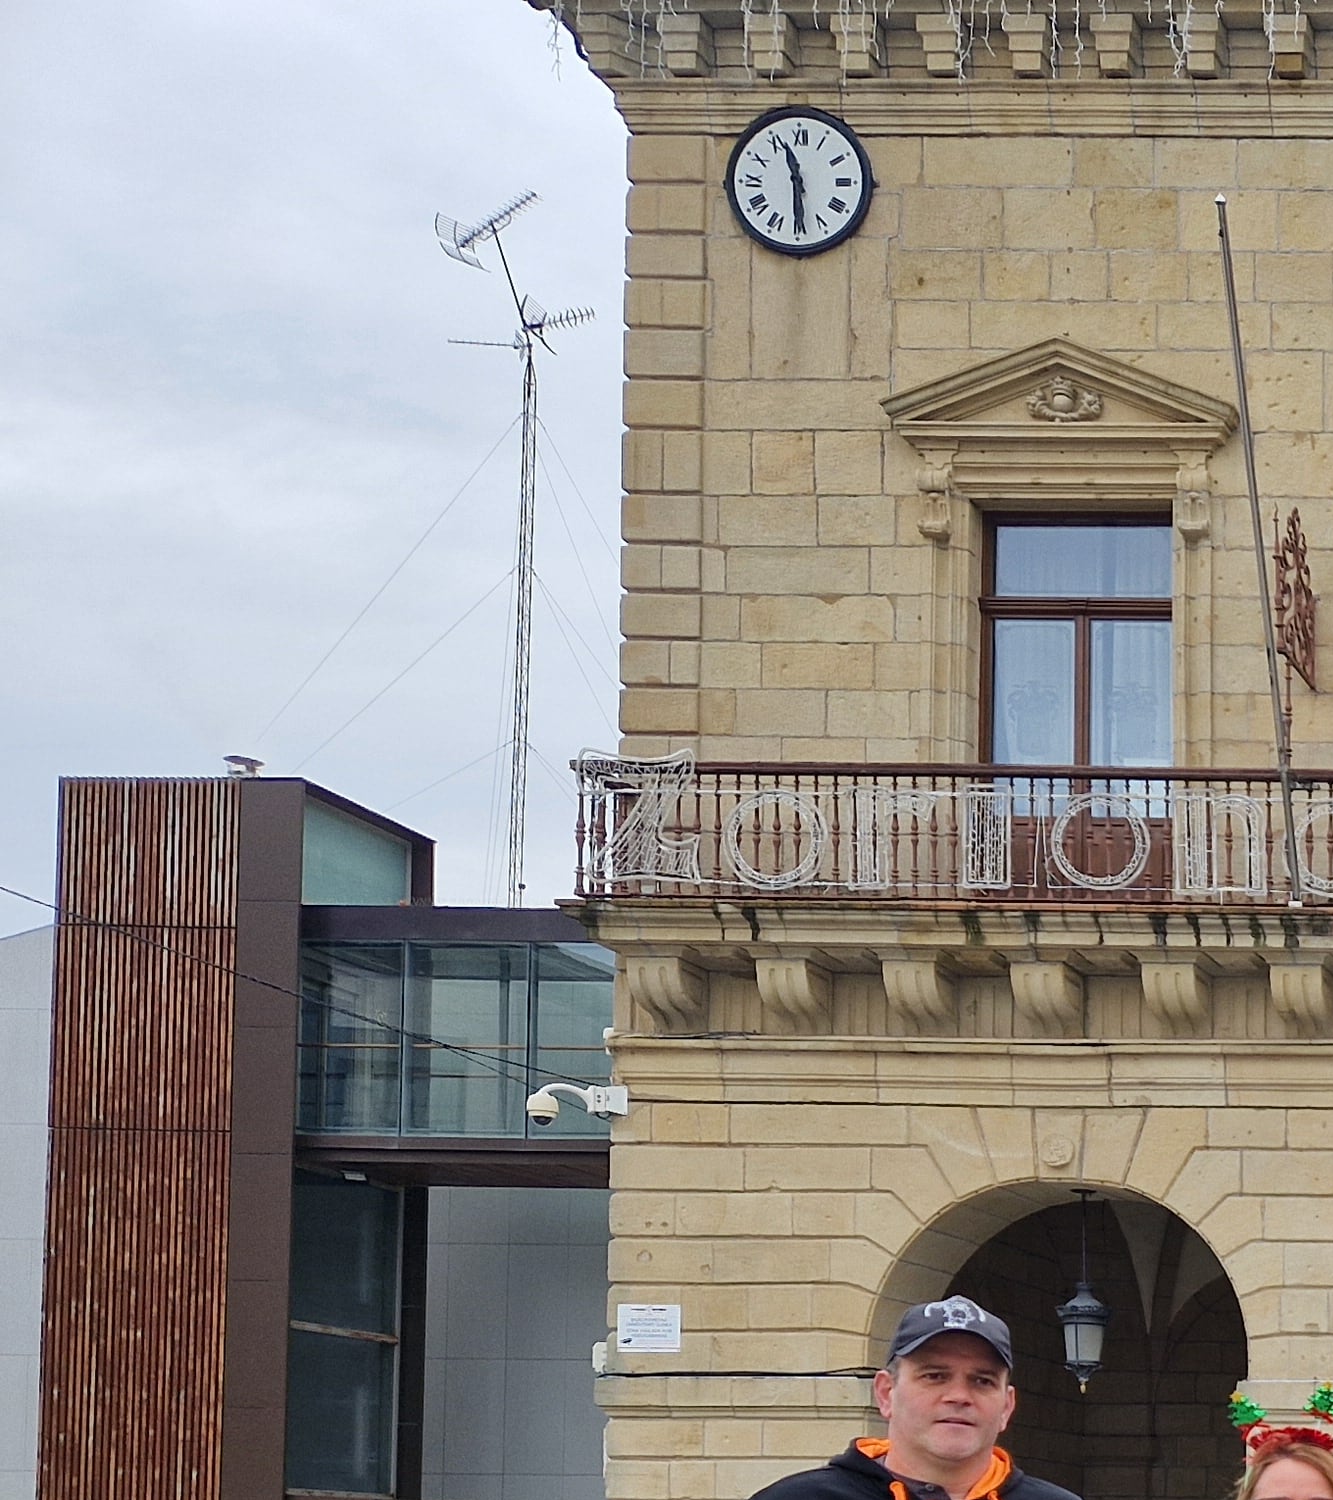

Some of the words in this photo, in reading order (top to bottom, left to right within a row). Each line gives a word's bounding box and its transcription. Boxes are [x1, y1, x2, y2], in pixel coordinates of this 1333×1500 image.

[792, 129, 808, 146] XII
[751, 153, 770, 168] X
[745, 174, 763, 188] IX
